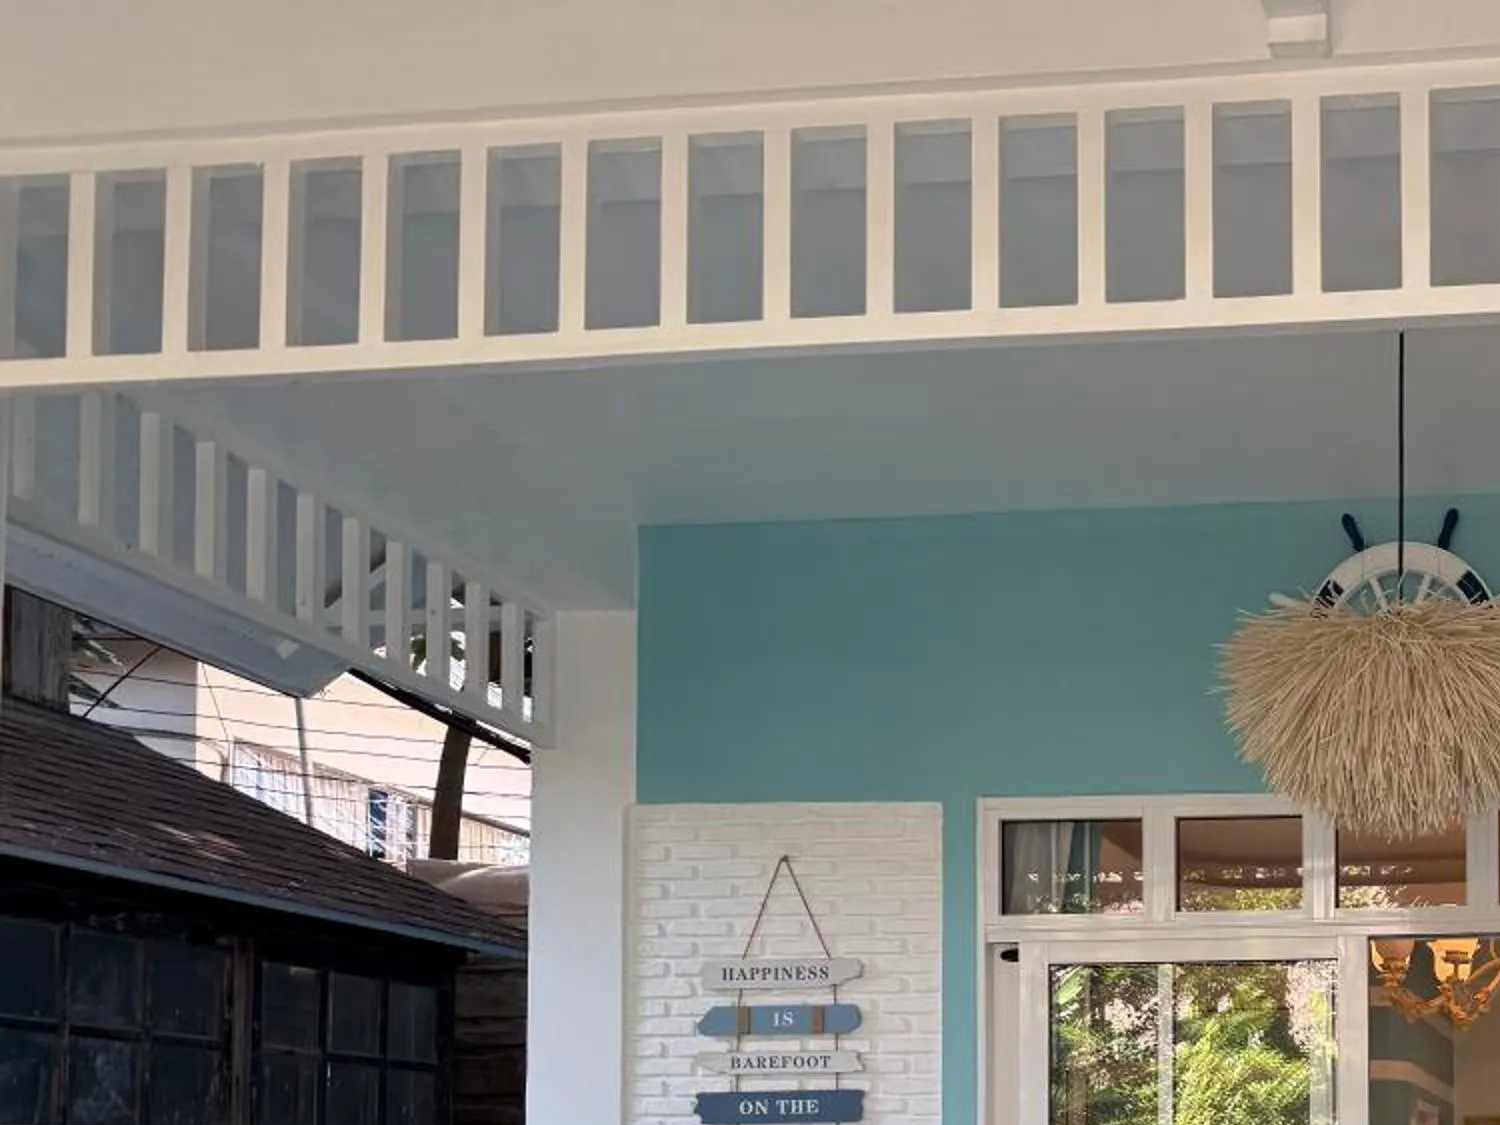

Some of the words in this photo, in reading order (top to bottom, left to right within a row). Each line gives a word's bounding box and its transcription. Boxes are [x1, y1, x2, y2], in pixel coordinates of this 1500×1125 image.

[721, 966, 830, 982] HAPPINESS
[771, 1010, 795, 1028] IS
[730, 1055, 832, 1070] BAREFOOT
[738, 1100, 769, 1115] ON
[776, 1098, 820, 1114] THE
